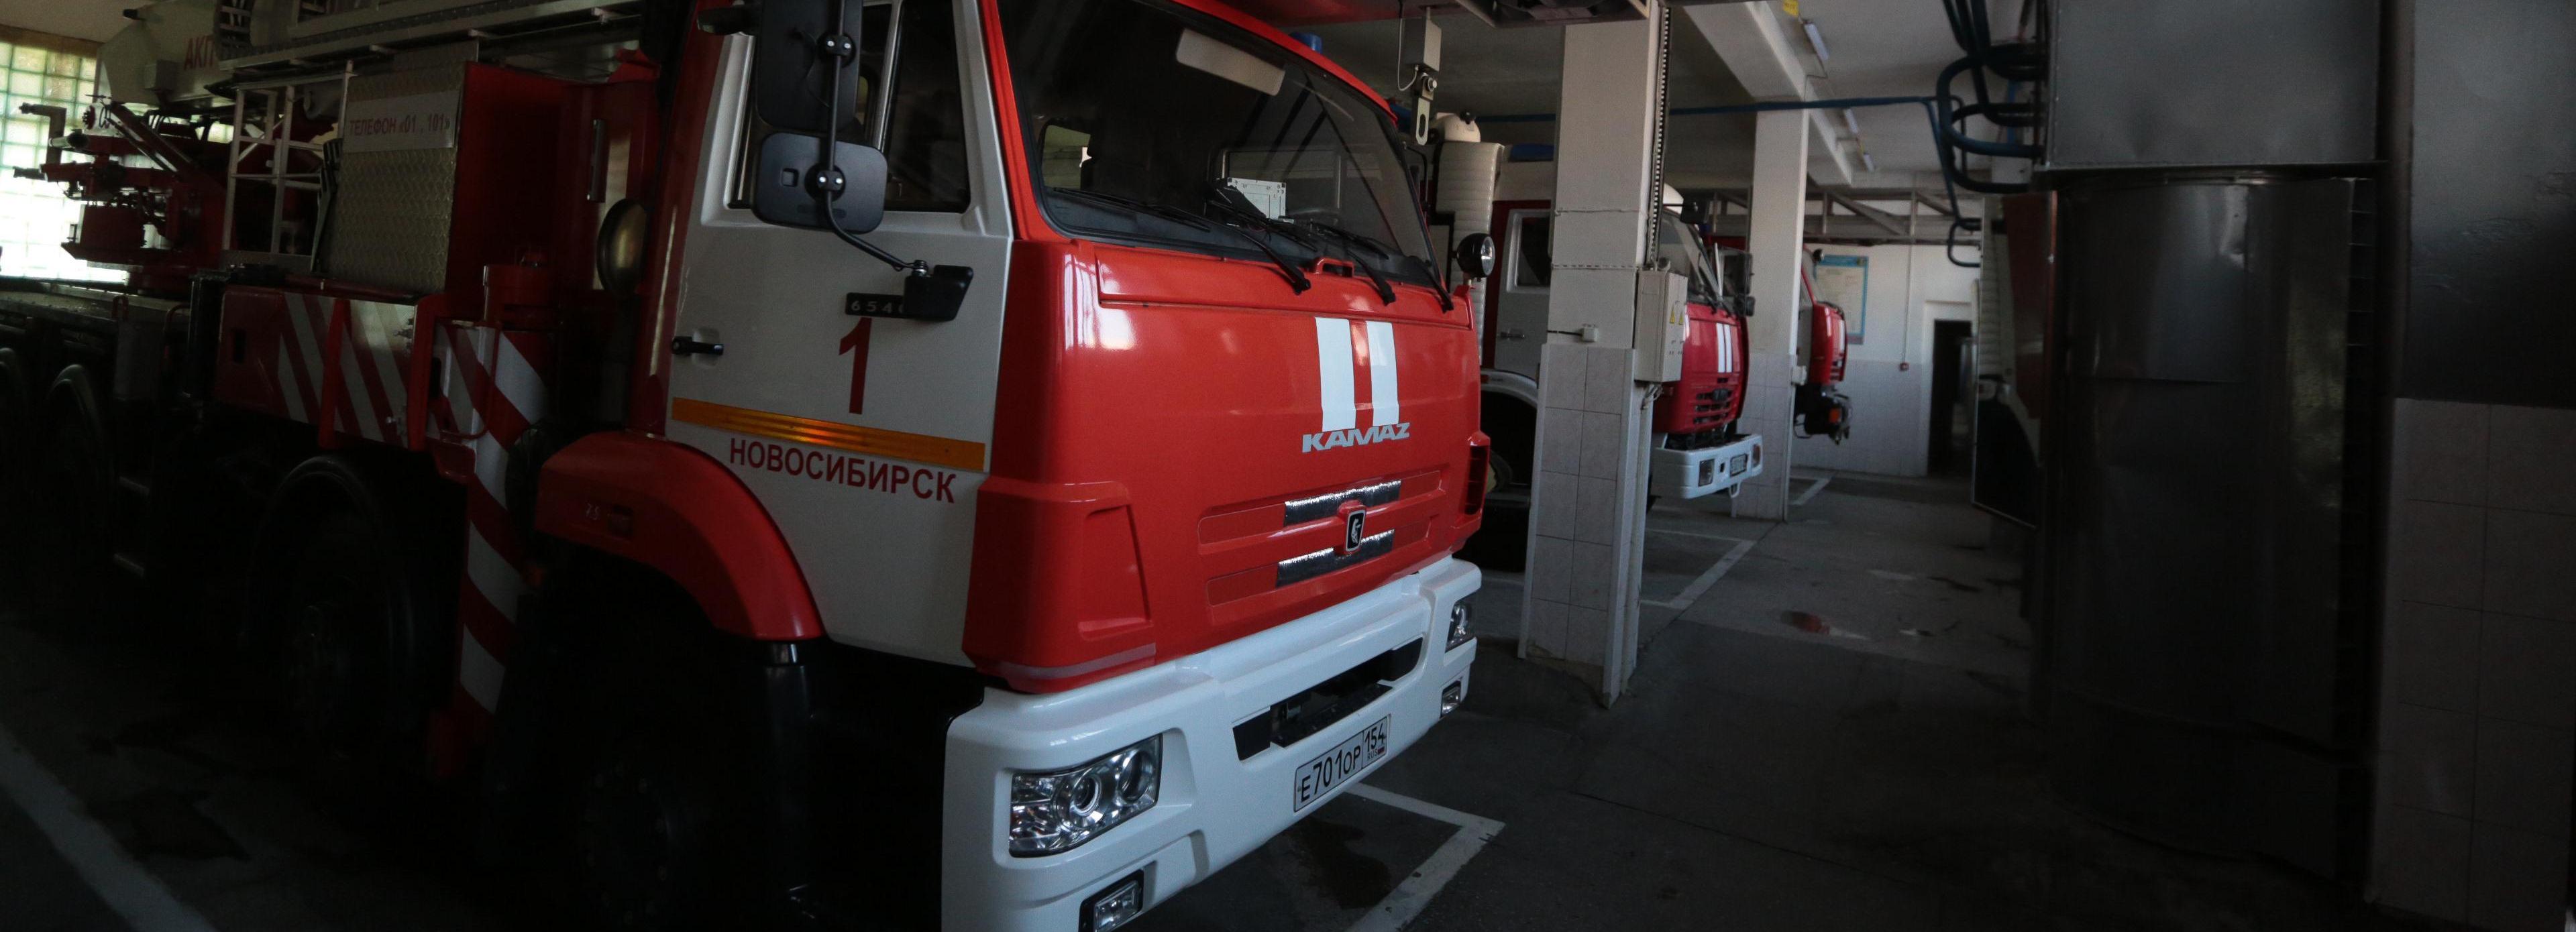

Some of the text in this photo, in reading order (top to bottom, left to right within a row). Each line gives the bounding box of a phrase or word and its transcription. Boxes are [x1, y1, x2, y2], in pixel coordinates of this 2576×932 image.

[350, 117, 396, 135] ТЕЛЕФОН
[839, 317, 872, 414] 1
[1302, 422, 1410, 453] KAMAZ
[730, 438, 956, 504] НОВОСИБИРСК
[1364, 723, 1385, 752] 154
[1368, 748, 1378, 761] RUS
